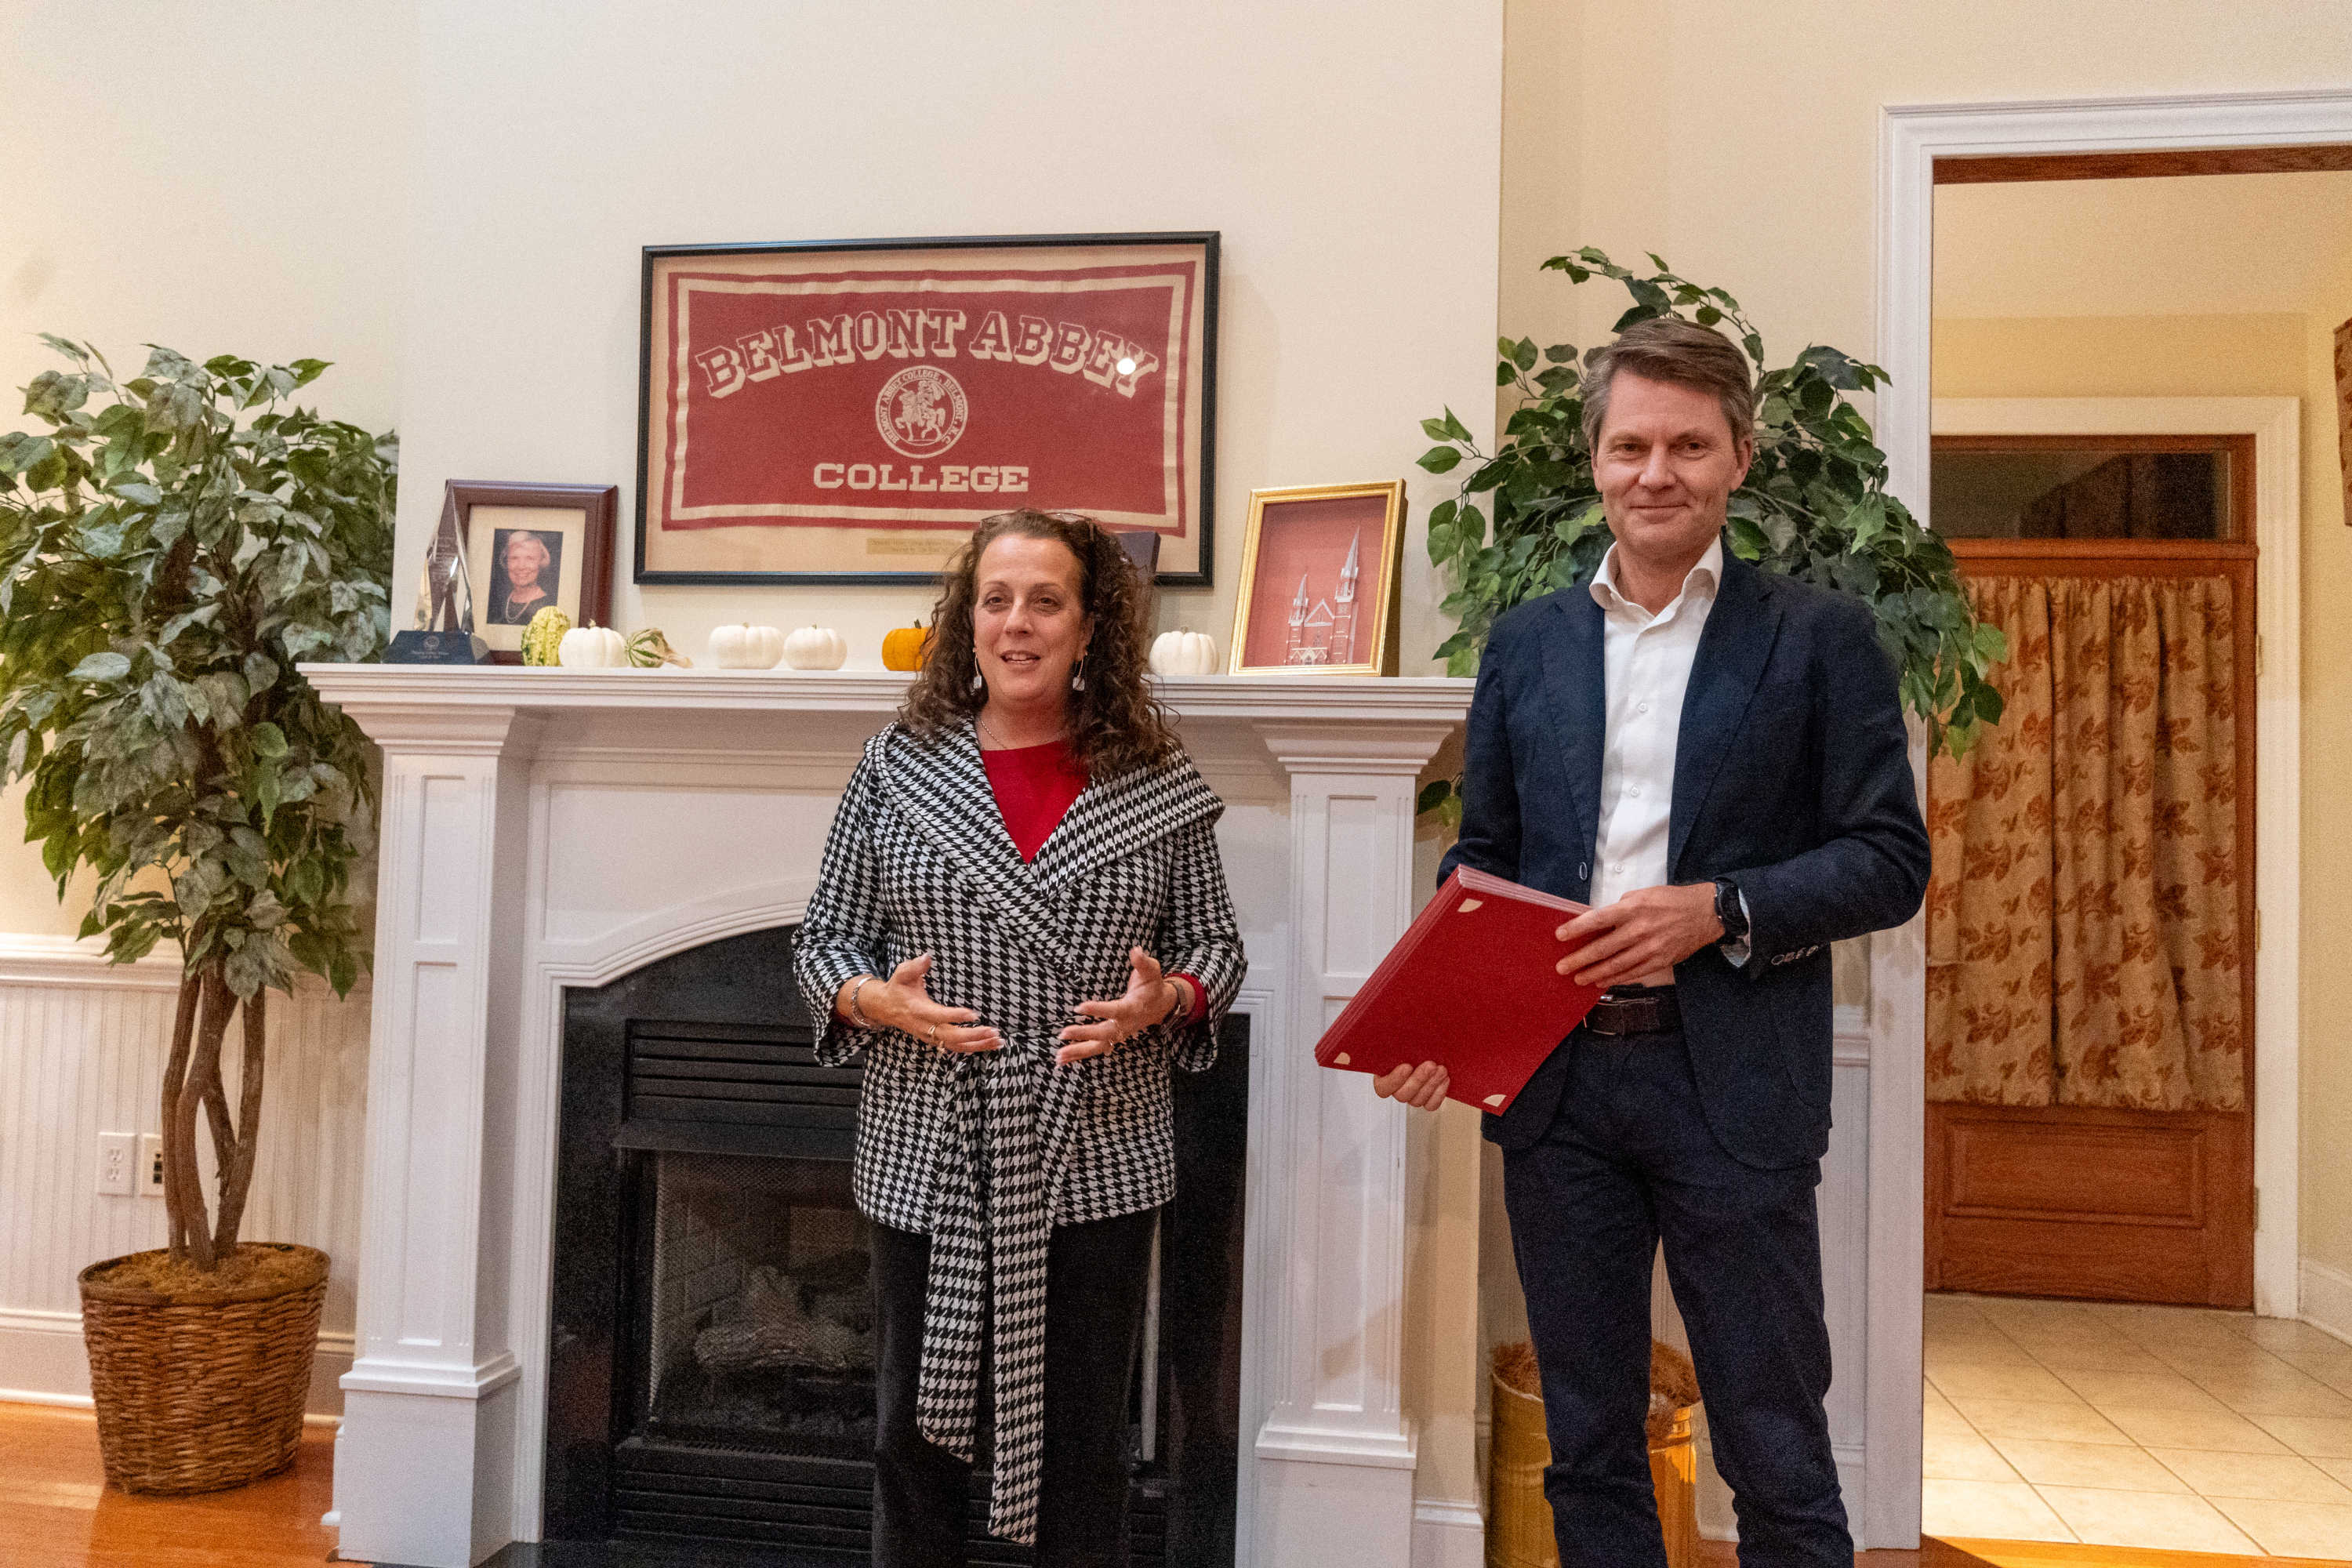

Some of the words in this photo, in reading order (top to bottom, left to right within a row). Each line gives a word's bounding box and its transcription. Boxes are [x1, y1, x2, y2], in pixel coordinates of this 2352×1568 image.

[695, 308, 967, 398] BELMONT
[969, 311, 1160, 398] ABBEY
[813, 463, 1029, 492] COLLEGE
